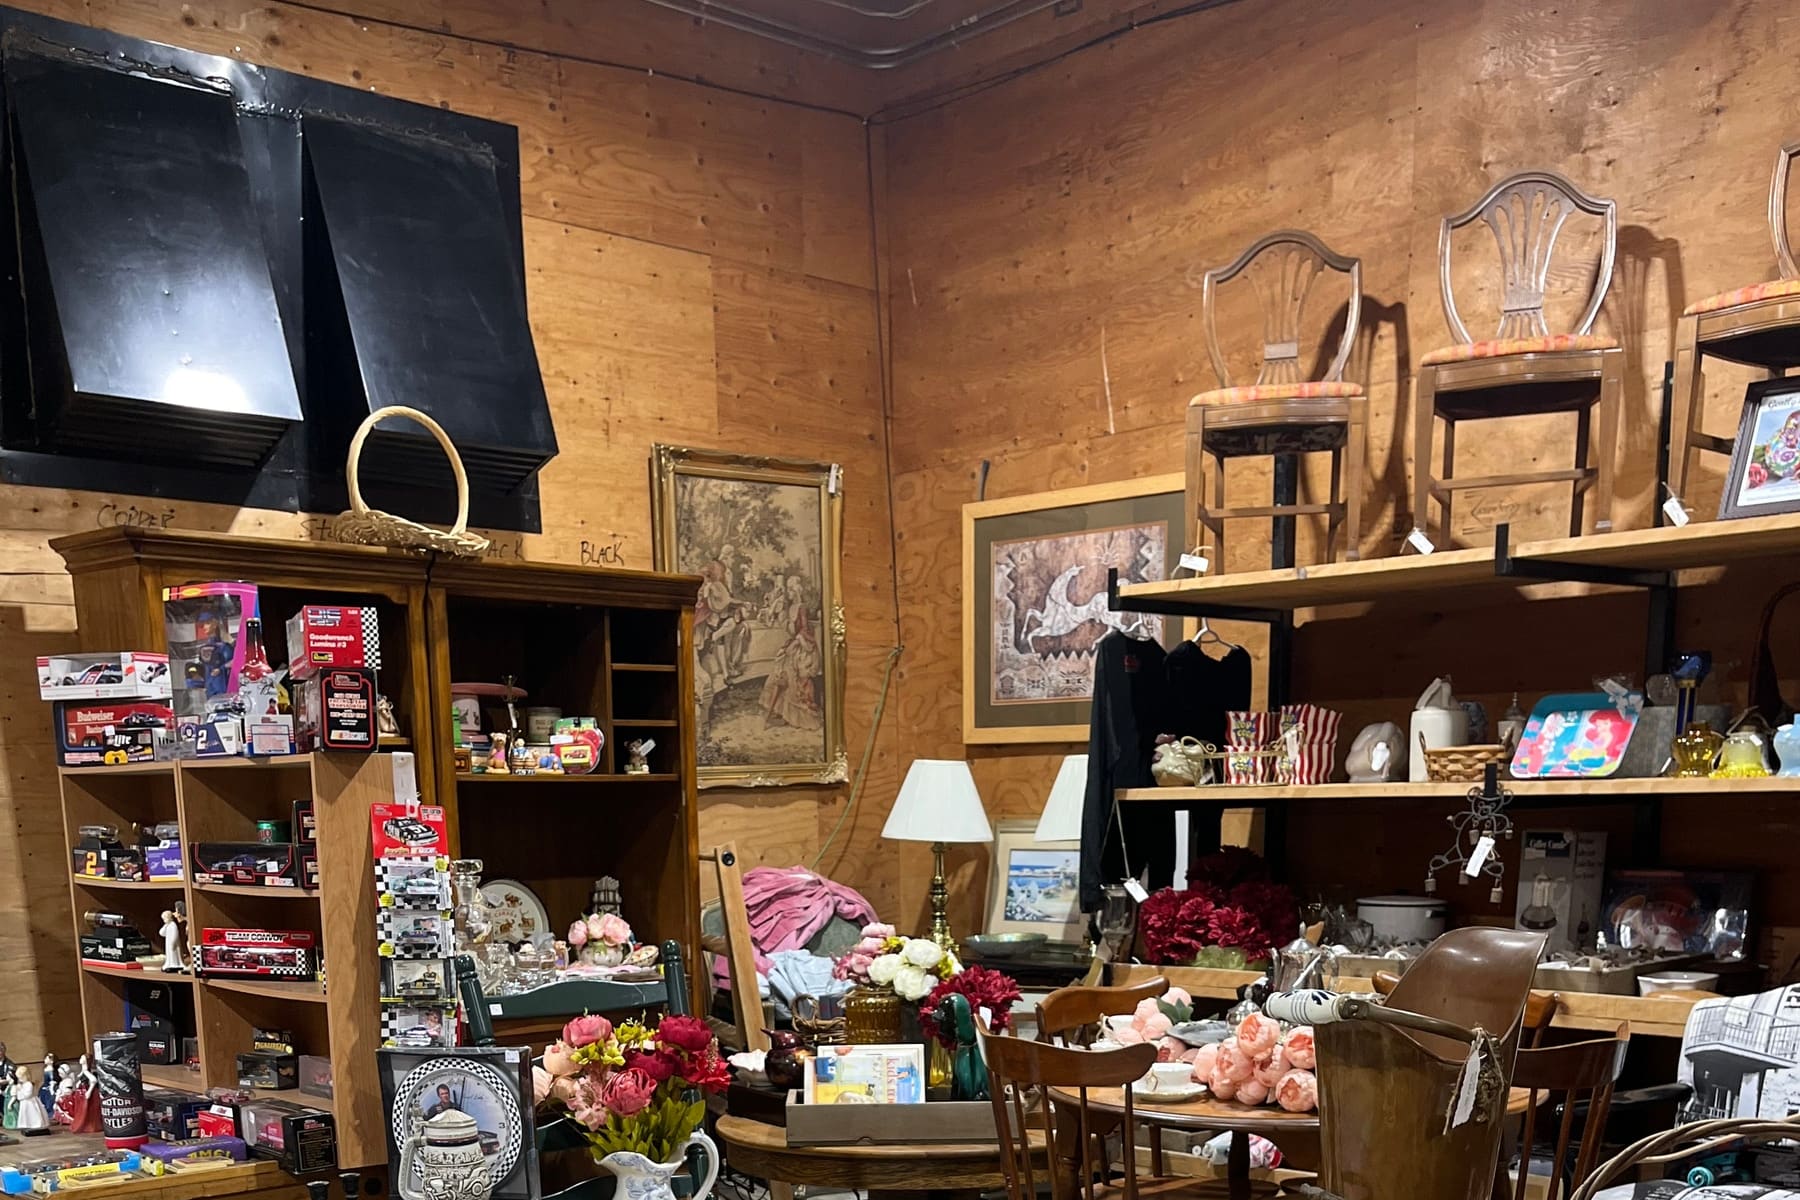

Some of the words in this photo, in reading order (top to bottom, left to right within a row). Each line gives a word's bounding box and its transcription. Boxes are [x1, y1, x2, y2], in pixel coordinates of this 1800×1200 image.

[580, 540, 625, 566] BLACK
[77, 711, 114, 722] Budweiser
[114, 735, 132, 747] Lite
[197, 729, 208, 750] 2
[86, 851, 97, 875] 2
[101, 1096, 131, 1107] MOTOR
